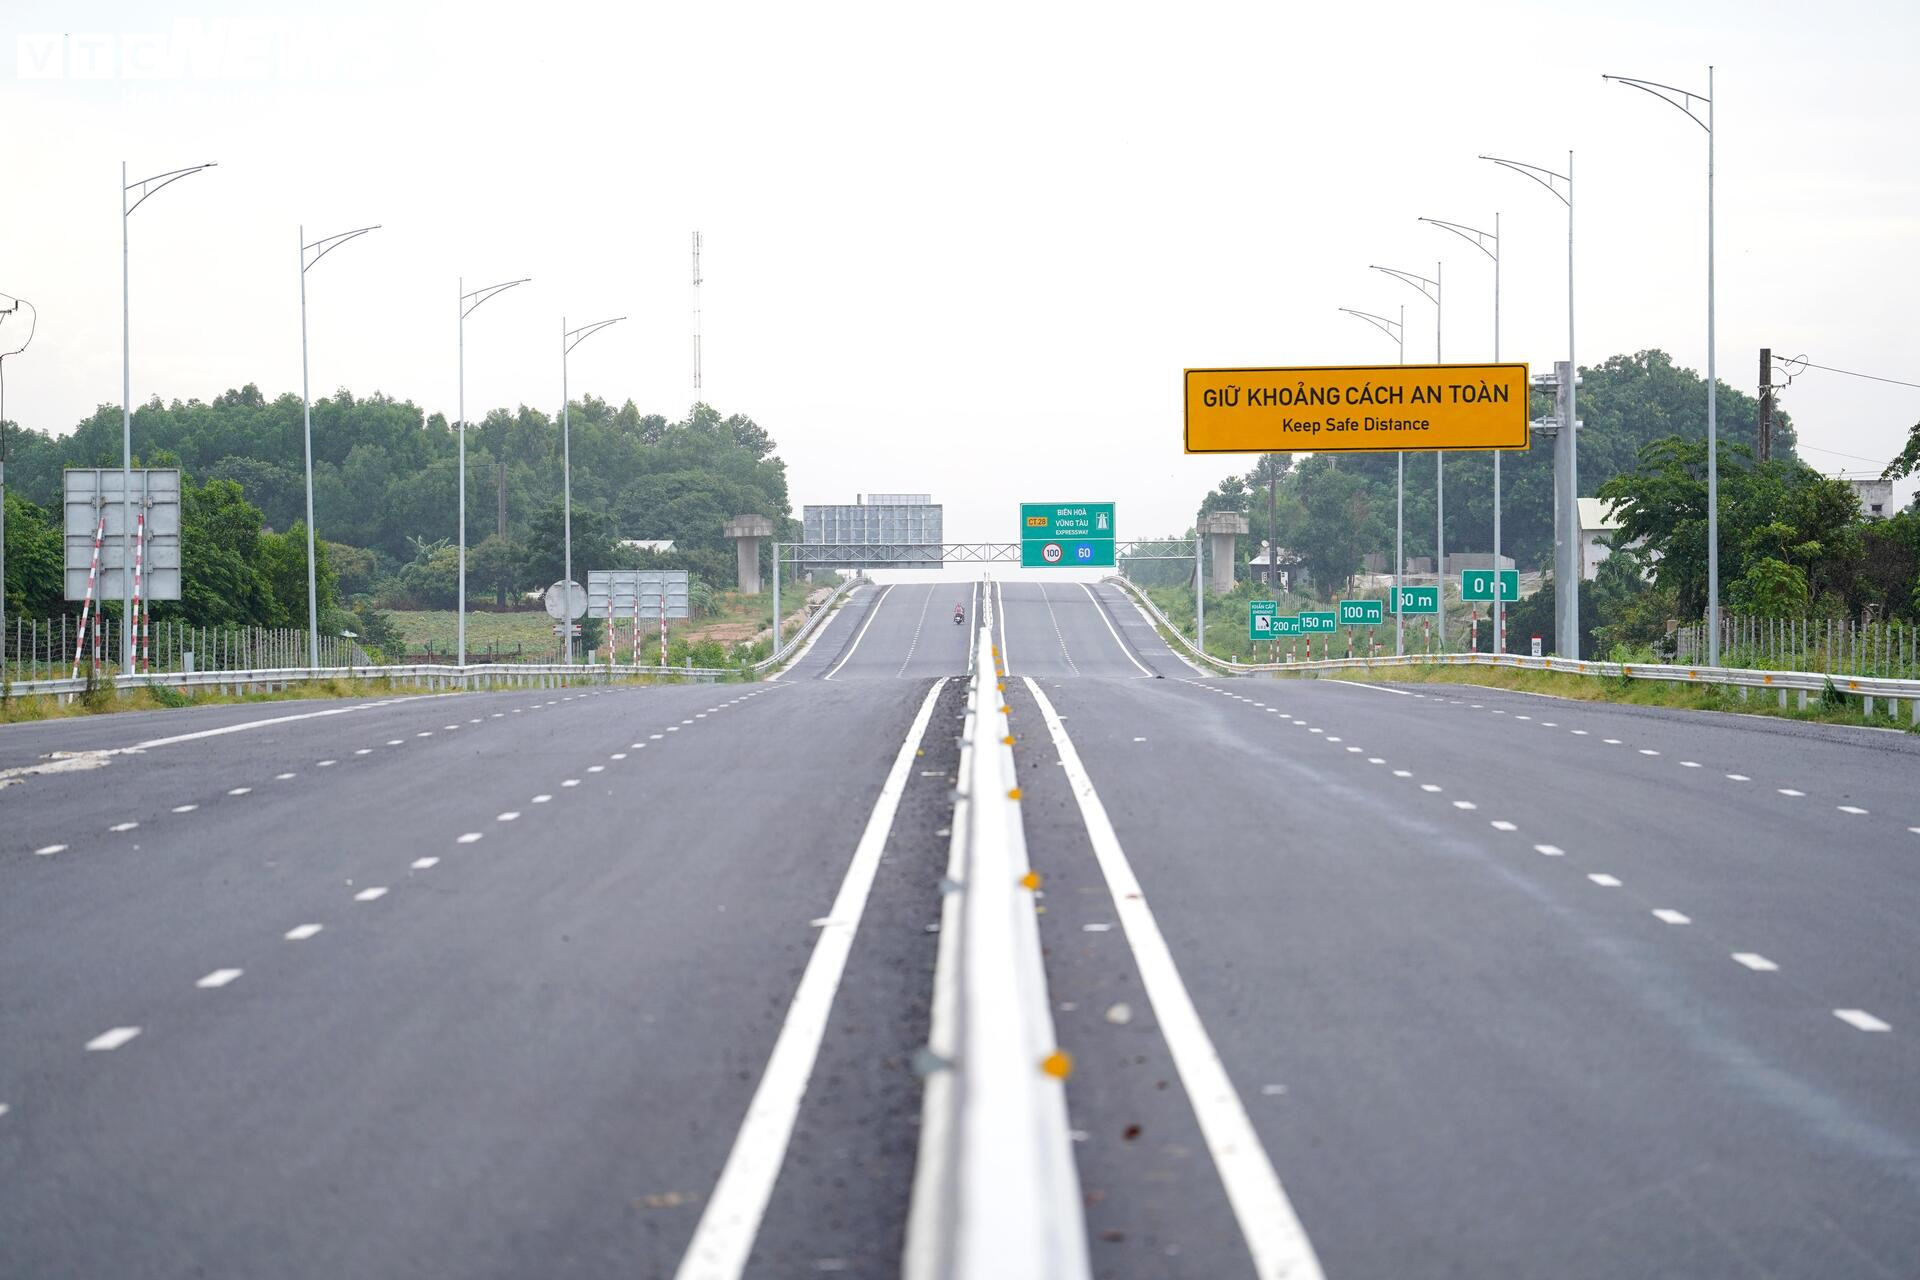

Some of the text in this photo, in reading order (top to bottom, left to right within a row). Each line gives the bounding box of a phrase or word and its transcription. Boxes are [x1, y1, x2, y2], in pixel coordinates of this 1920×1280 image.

[1203, 381, 1509, 407] GIỮ KHOẢNG CÁCH AN TOÀN
[1283, 417, 1430, 435] Keep Safe Distance
[1047, 549, 1059, 557] 100
[1078, 548, 1090, 557] 60
[1474, 578, 1484, 593] 0
[1418, 597, 1432, 607] m
[1343, 607, 1379, 618] 100 m
[1273, 622, 1289, 631] 200
[1302, 617, 1333, 628] 150 m
